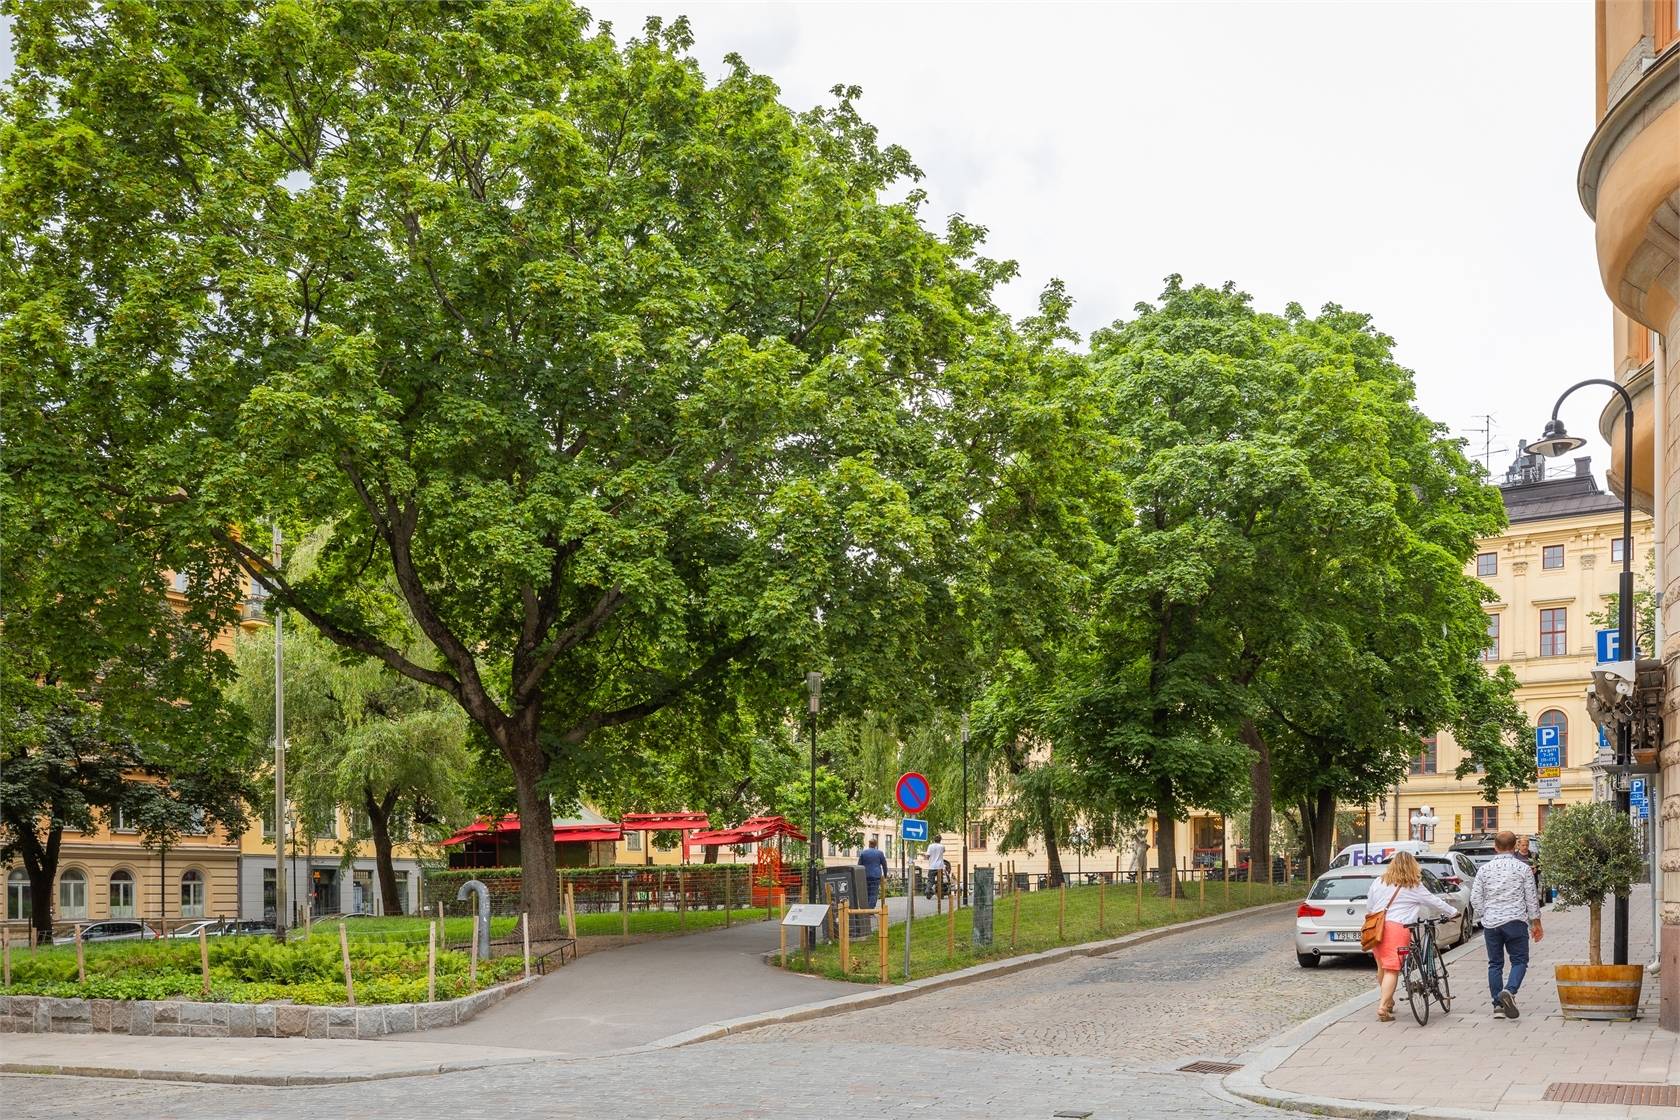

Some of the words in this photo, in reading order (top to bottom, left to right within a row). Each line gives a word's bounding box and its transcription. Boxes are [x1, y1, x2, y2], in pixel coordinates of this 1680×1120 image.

[1542, 729, 1555, 745] P
[1633, 781, 1641, 792] P
[1336, 931, 1350, 939] YSL
[1352, 931, 1361, 939] 88
